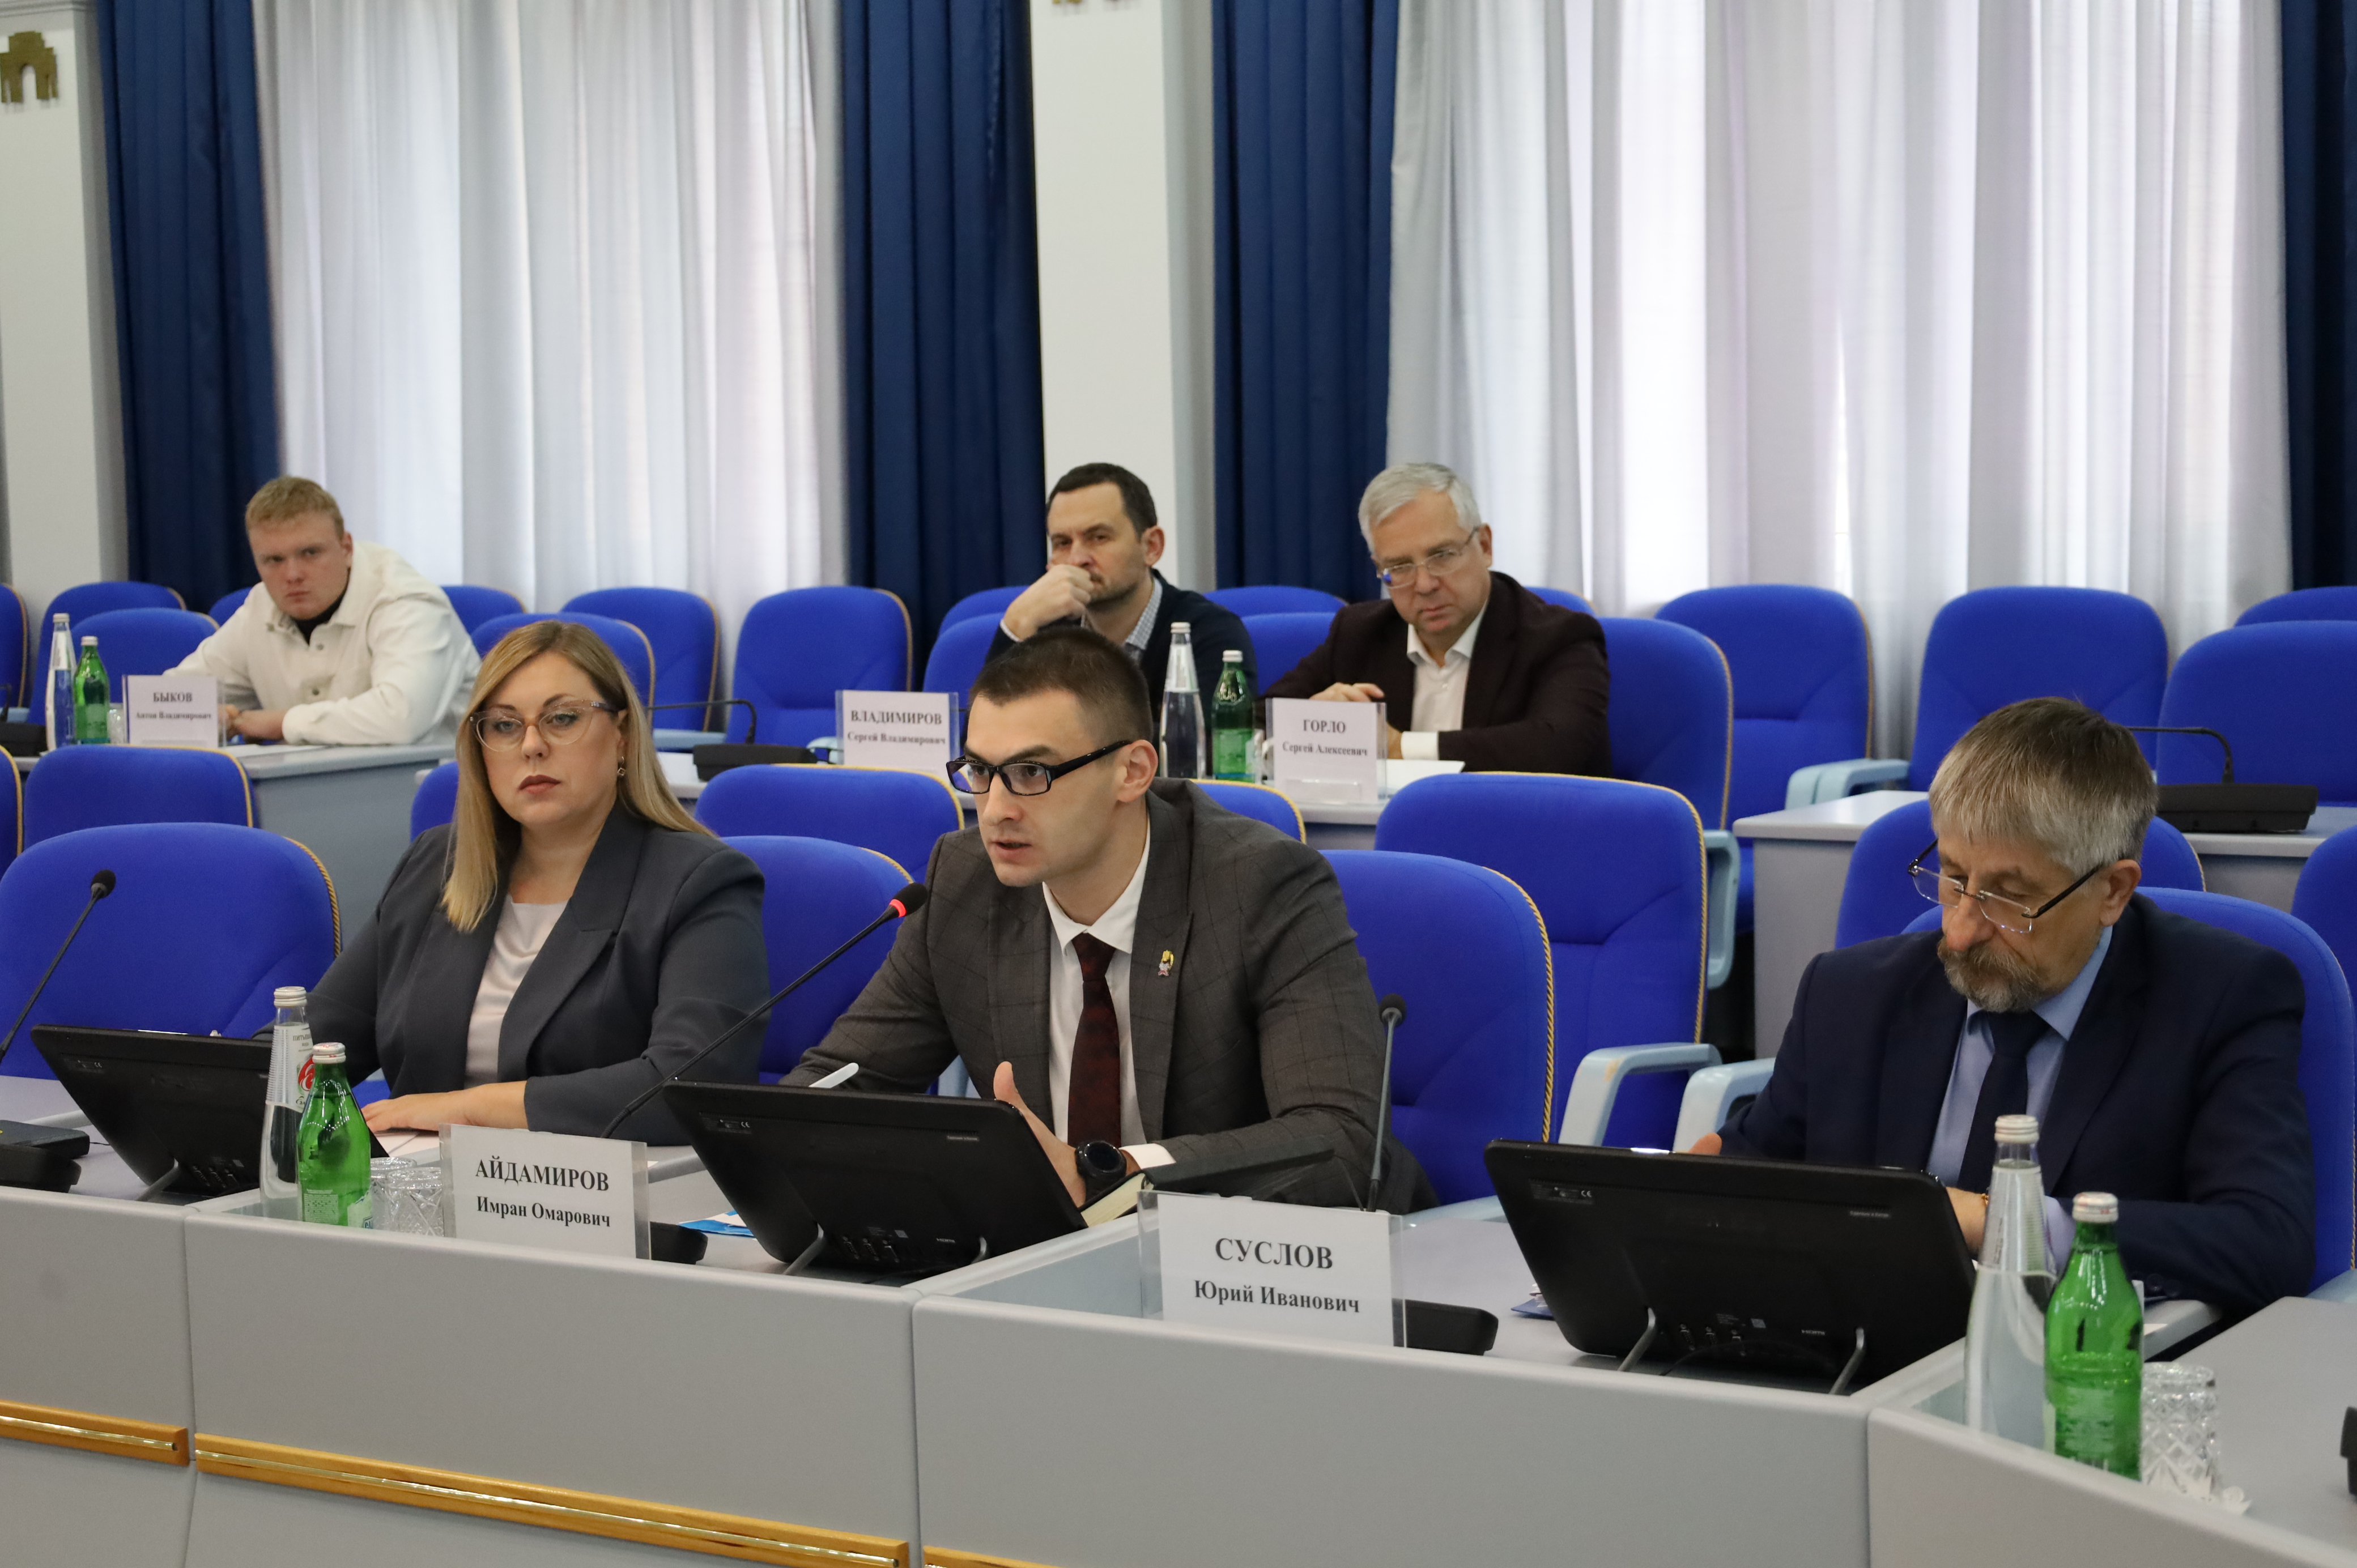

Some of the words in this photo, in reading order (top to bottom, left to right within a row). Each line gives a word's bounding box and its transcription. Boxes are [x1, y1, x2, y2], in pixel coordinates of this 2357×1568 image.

[154, 692, 193, 702] БЫКОВ
[851, 710, 942, 725] ВЛАДИМИРОВ
[1303, 719, 1346, 734] ГОРЛО
[847, 731, 878, 743] Сергей
[880, 733, 946, 745] Владимирович
[1282, 741, 1313, 754] Сергей
[1316, 744, 1368, 756] Алексеевич
[475, 1155, 610, 1191] АЙДАМИРОВ
[476, 1196, 527, 1219] Имран
[531, 1202, 610, 1227] Омарович
[1215, 1238, 1333, 1269] СУСЛОВ
[1194, 1280, 1253, 1305] Юрий
[1260, 1286, 1360, 1313] Иванович
